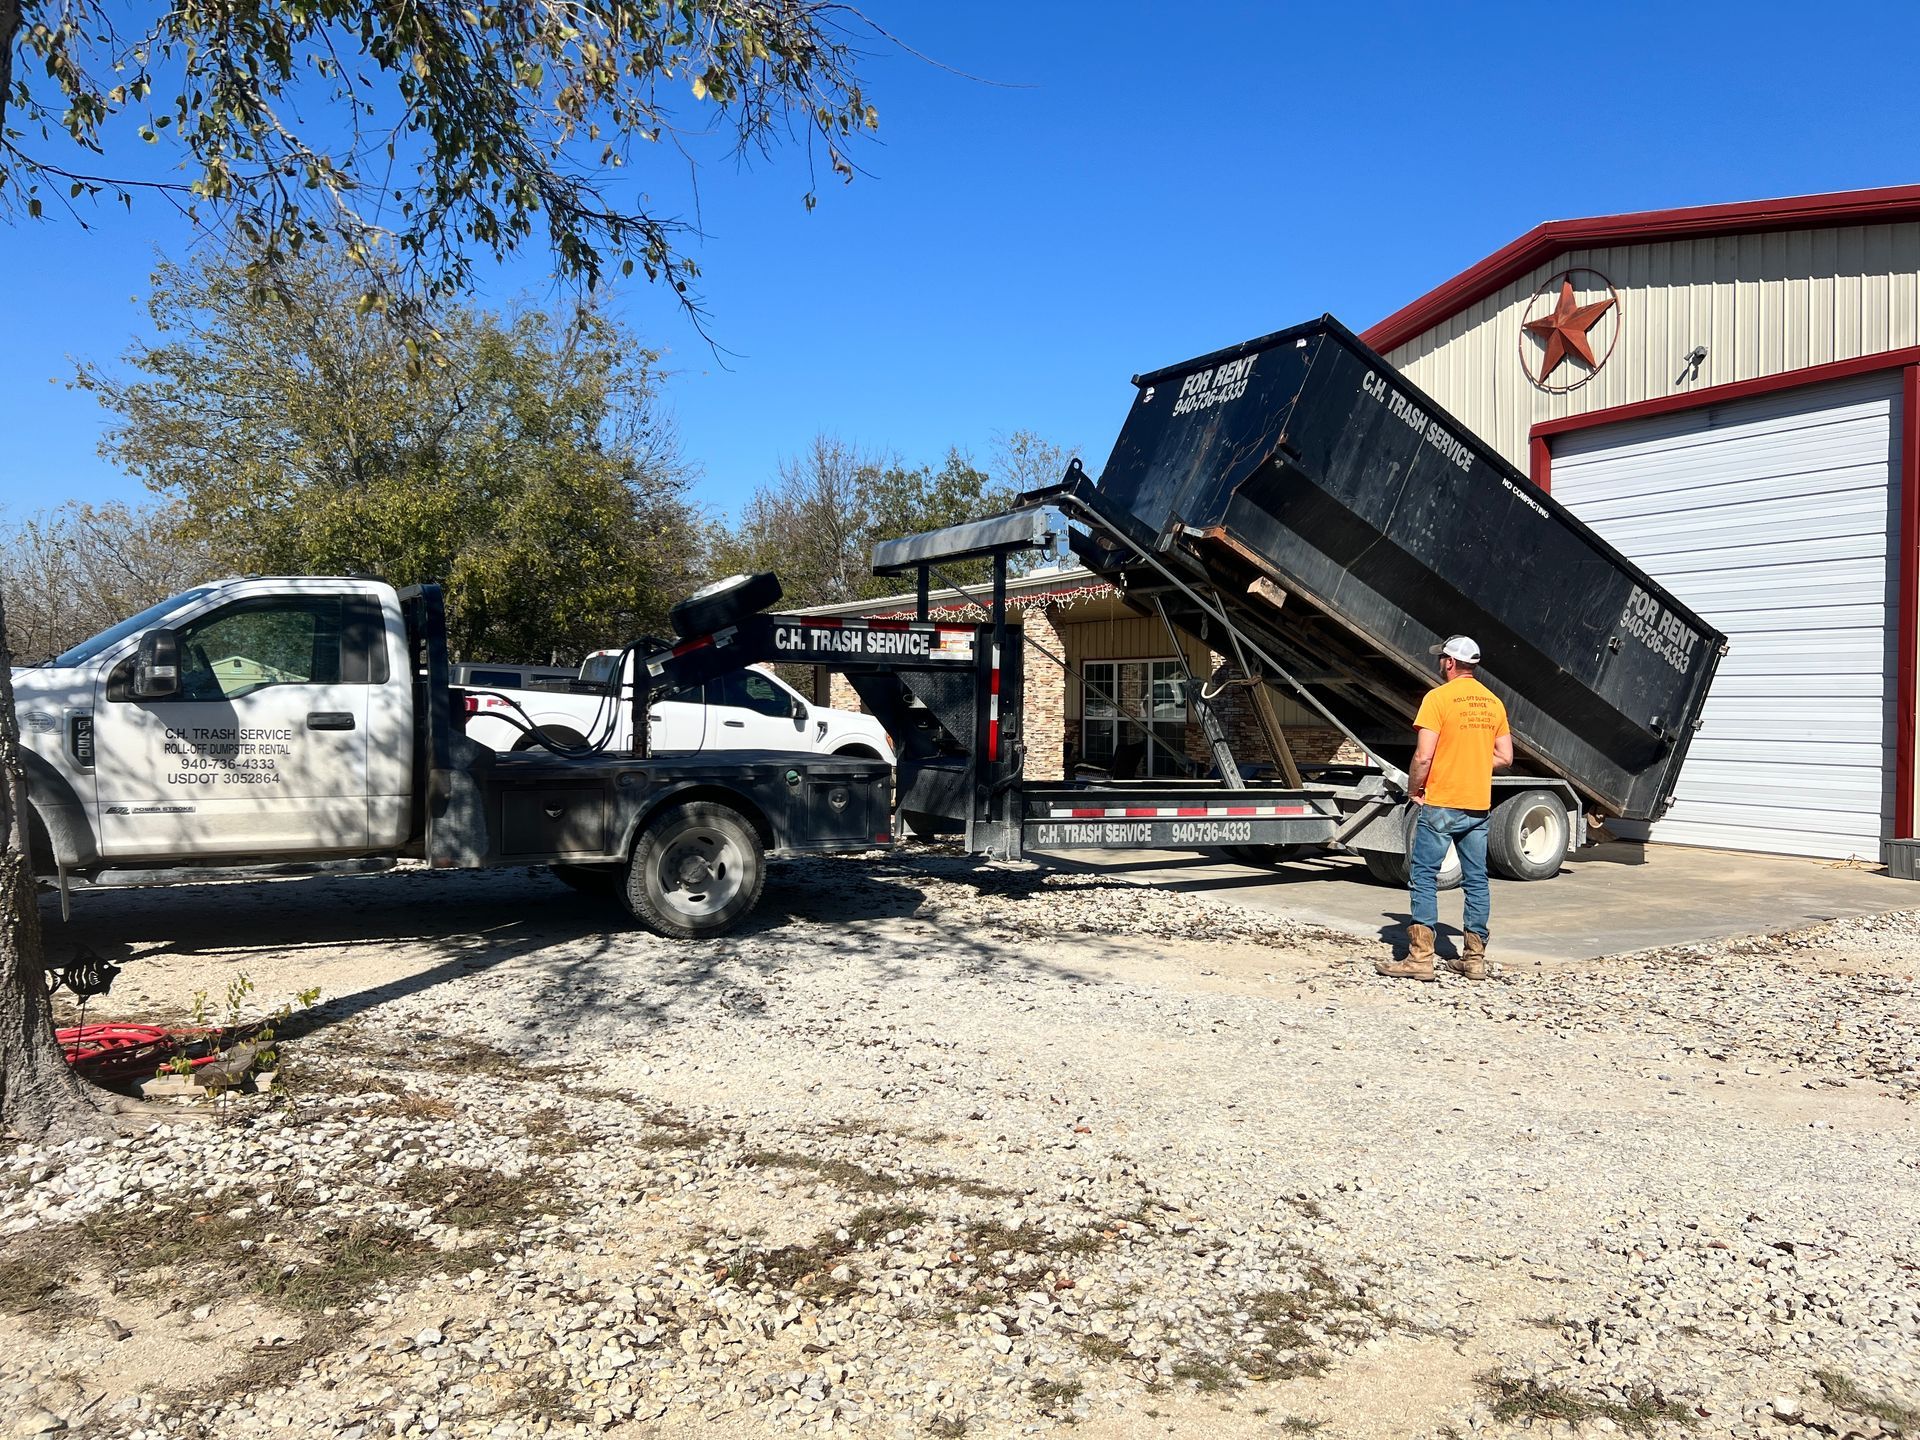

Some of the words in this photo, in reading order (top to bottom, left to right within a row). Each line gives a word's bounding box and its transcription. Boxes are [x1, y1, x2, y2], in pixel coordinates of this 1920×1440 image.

[1179, 369, 1213, 398] FOR
[1212, 353, 1259, 388] RENT
[1172, 378, 1248, 417] 940-736-4333
[1362, 370, 1387, 403] C.H.
[1388, 389, 1428, 435] TRASH
[1426, 421, 1476, 473] SERVICE
[1502, 478, 1513, 490] NO
[1512, 486, 1549, 519] COMPACTING
[1627, 584, 1660, 626] FOR
[1657, 609, 1699, 656] RENT
[775, 628, 806, 650] C.H.
[810, 629, 862, 653] TRASH
[866, 631, 930, 655] SERVICE
[1620, 608, 1690, 675] 940-736-4333
[164, 743, 208, 755] ROLL-OFF
[209, 743, 257, 755] DUMPSTER
[258, 743, 291, 755] RENTAL
[165, 728, 189, 740] C.H.
[193, 728, 236, 740] TRASH
[239, 729, 292, 740] SERVICE
[167, 773, 219, 784] USDOT
[223, 773, 281, 784] 3052864
[181, 758, 276, 770] 940-736-4333
[1037, 824, 1061, 844] C.H.
[1063, 824, 1103, 843] TRASH
[1105, 824, 1152, 843] SERVICE
[1171, 822, 1251, 843] 940-736-4333
